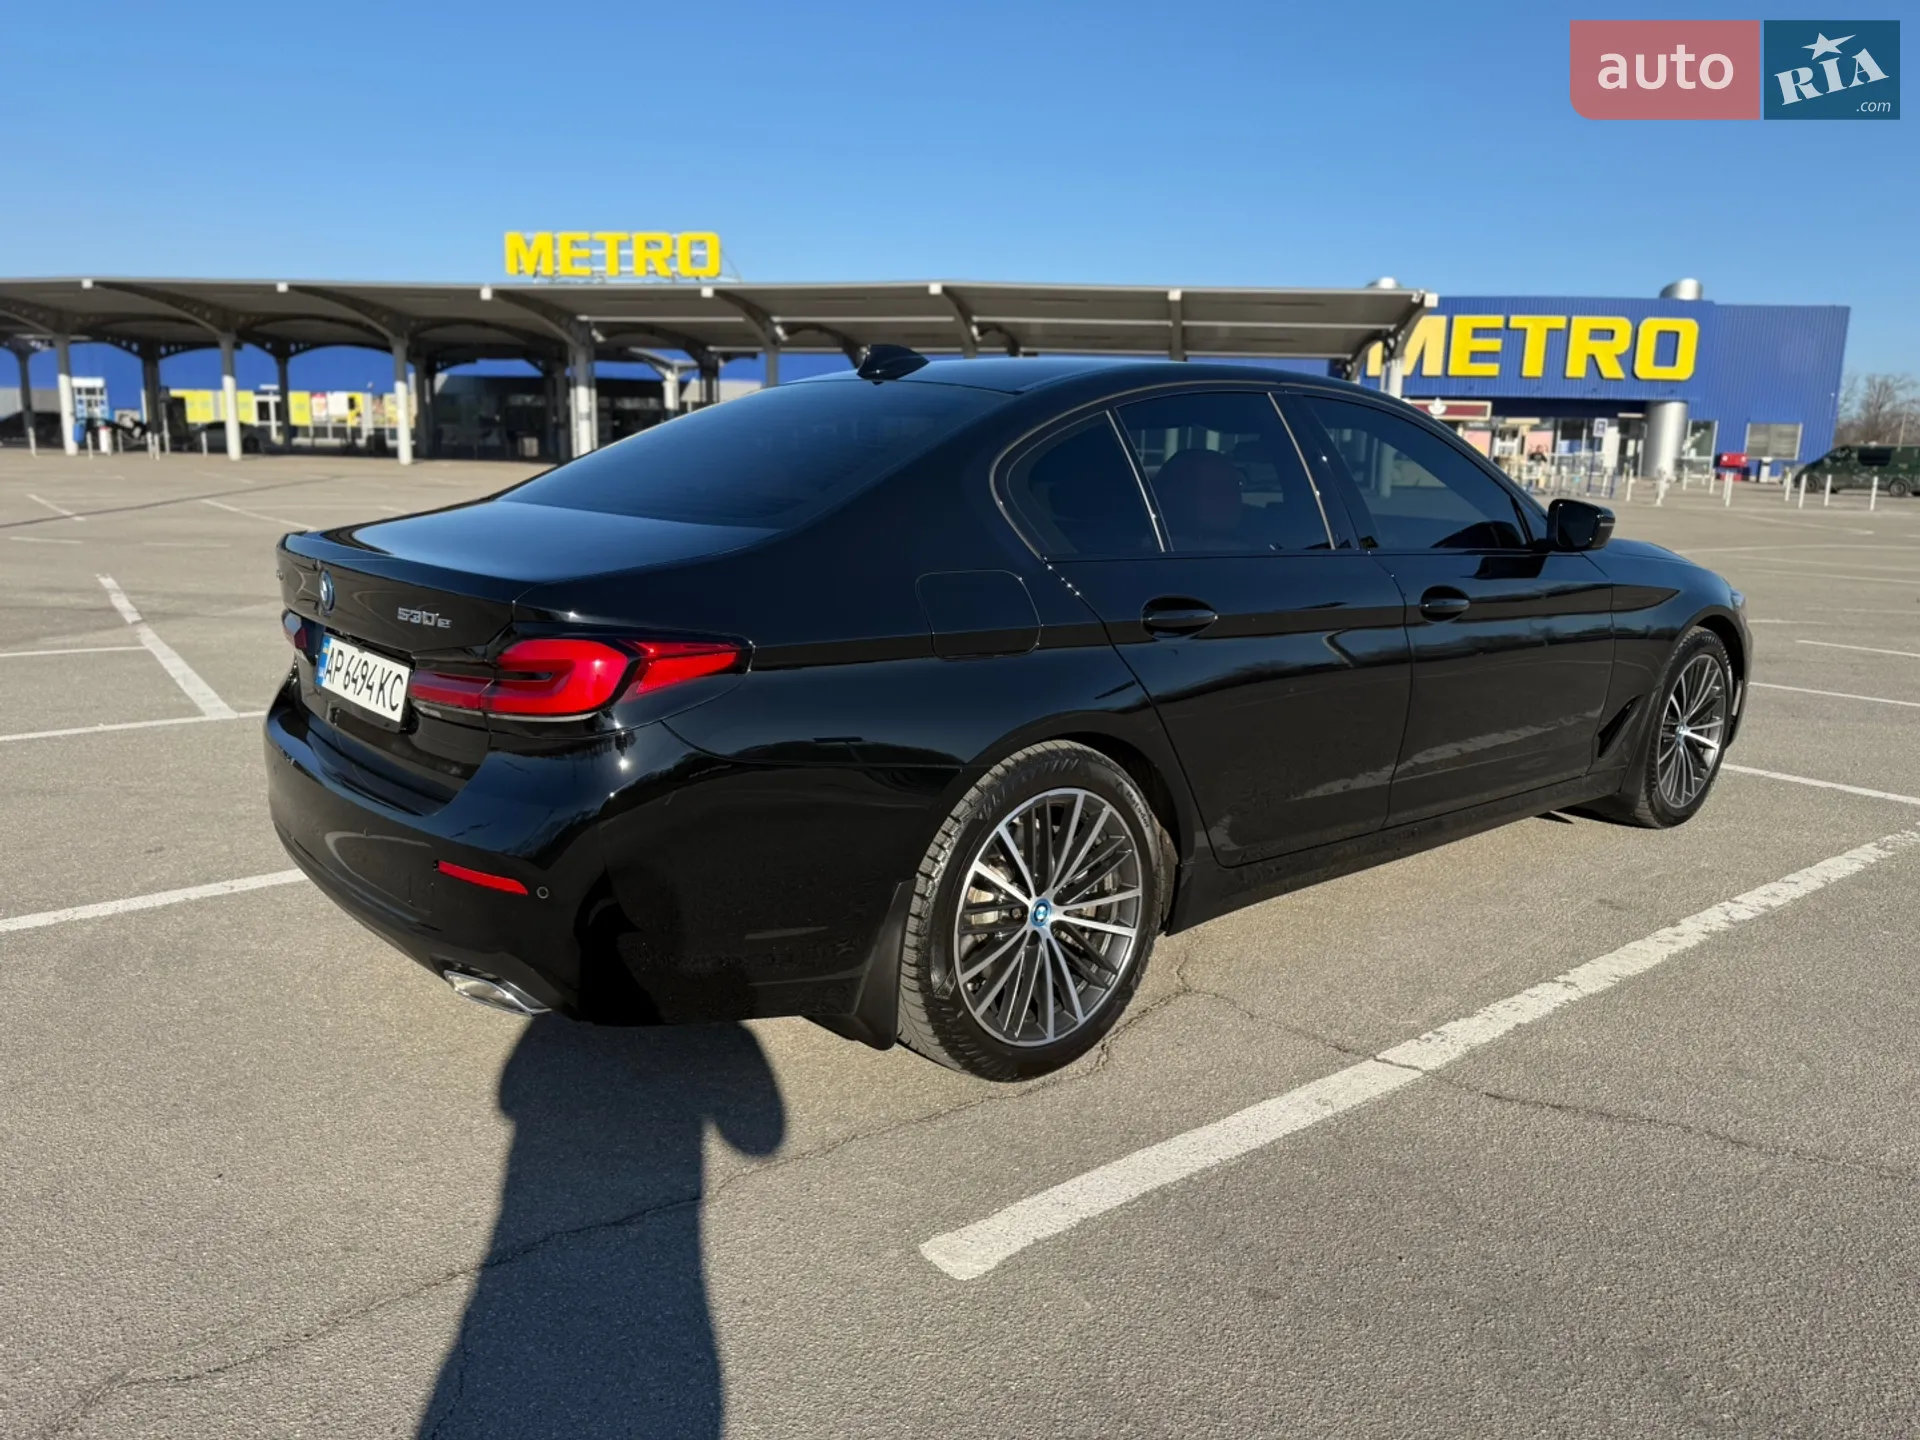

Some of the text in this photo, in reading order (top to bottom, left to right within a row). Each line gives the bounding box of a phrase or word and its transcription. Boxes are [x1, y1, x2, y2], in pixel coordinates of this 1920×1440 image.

[504, 231, 721, 278] METRO
[1366, 315, 1700, 381] METRO
[397, 606, 453, 629] 530e
